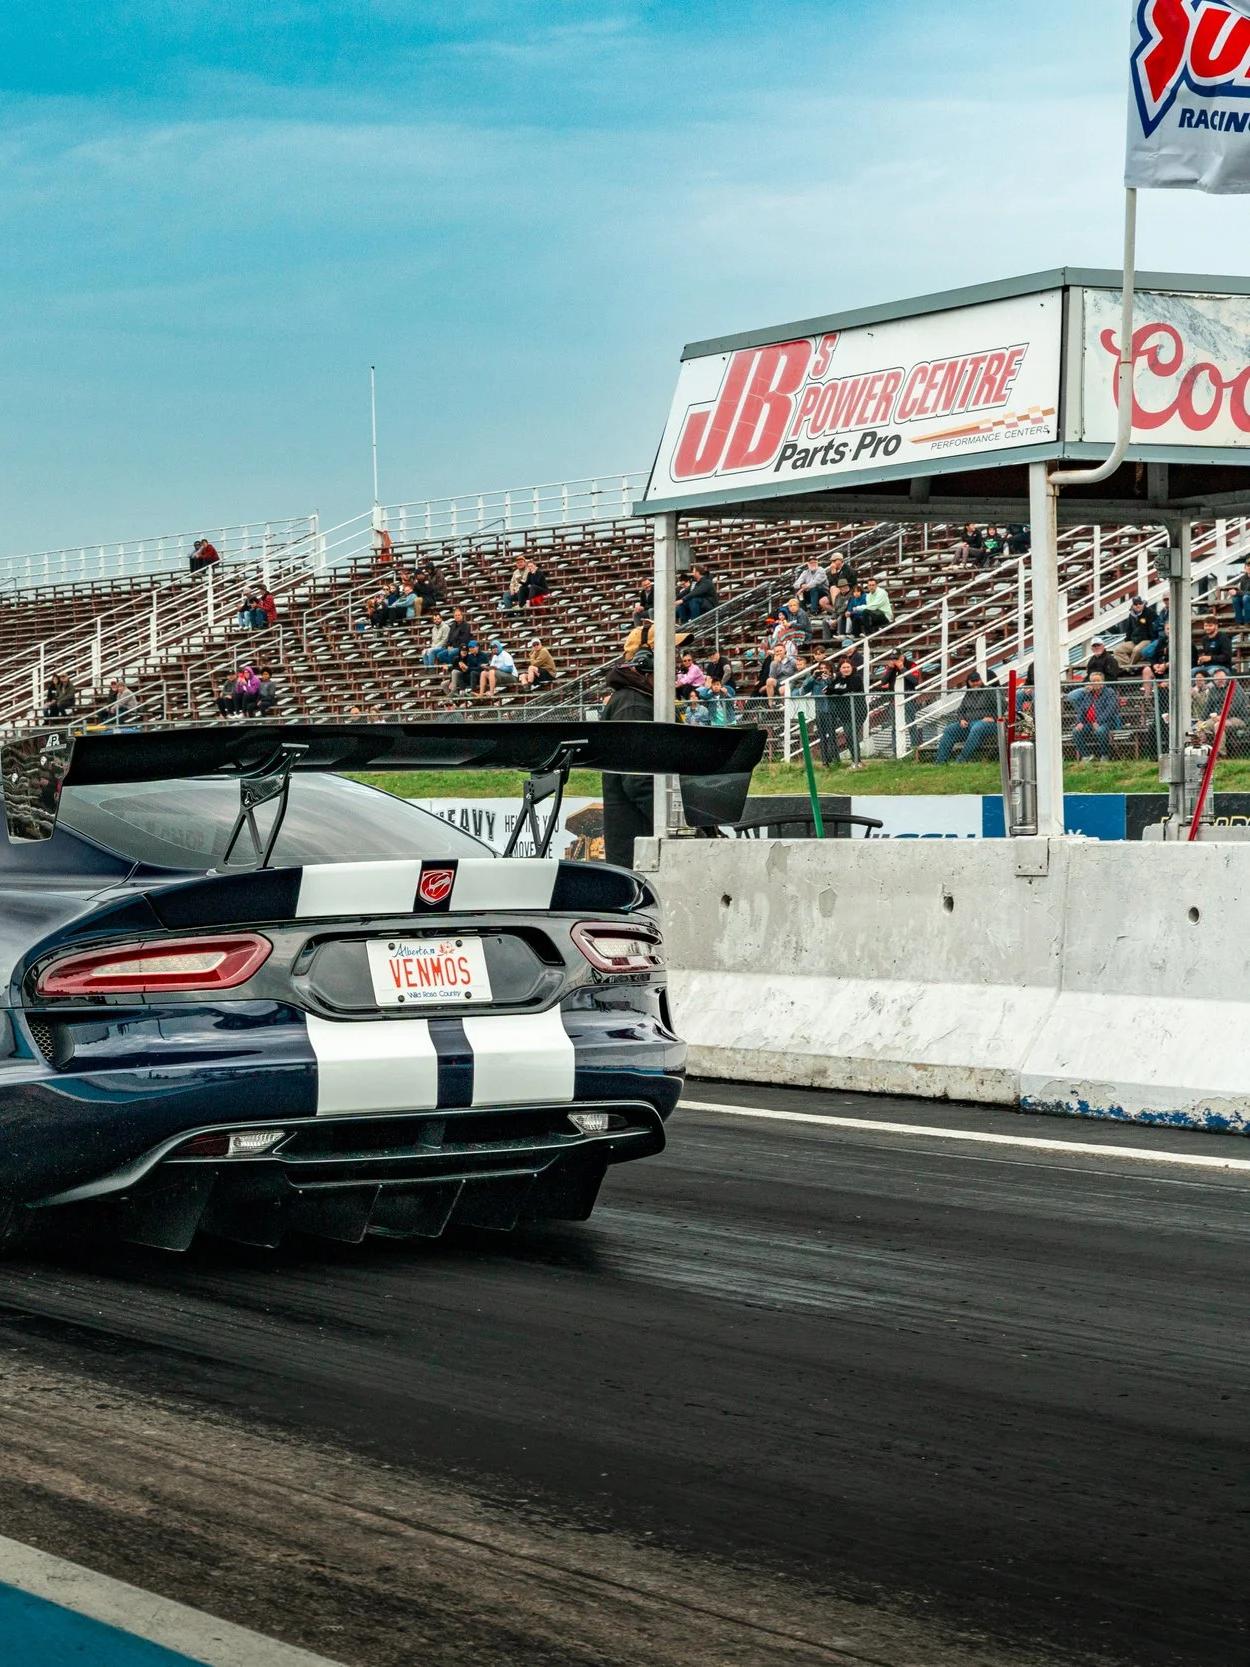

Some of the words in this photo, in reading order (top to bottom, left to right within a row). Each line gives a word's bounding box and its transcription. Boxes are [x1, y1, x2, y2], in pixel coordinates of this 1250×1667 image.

[1138, 0, 1250, 118] SU
[1178, 108, 1250, 133] RACIN
[791, 369, 903, 438] POWER
[899, 346, 1026, 420] CENTRE
[774, 437, 850, 473] Parts
[851, 431, 902, 462] Pro
[930, 432, 1001, 450] PERFORMANCE
[1004, 425, 1050, 439] CENTERS
[393, 943, 431, 957] Alberta
[388, 957, 472, 988] VENMOS
